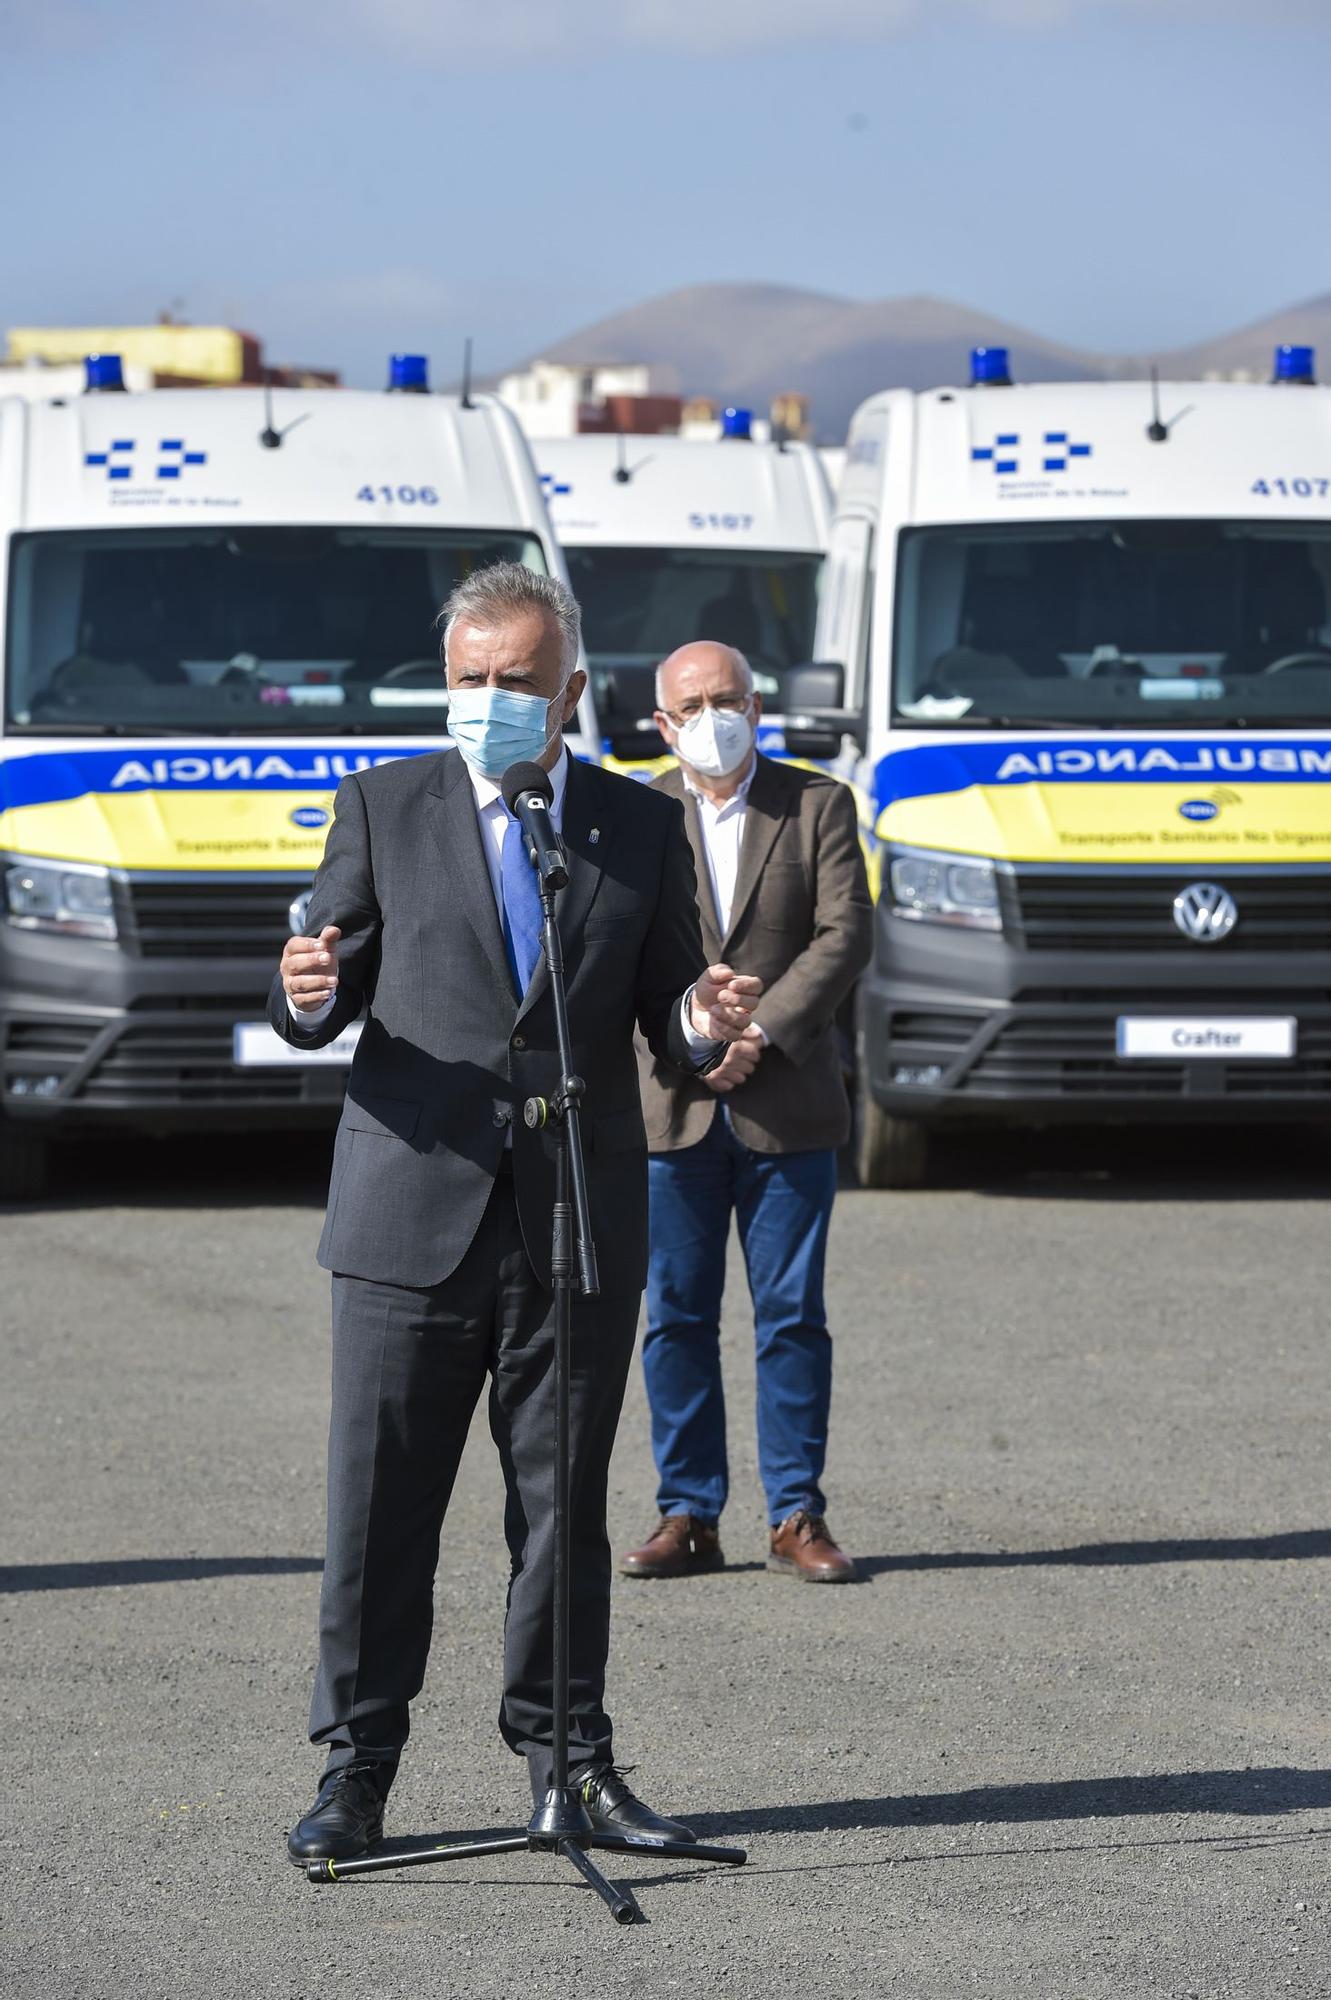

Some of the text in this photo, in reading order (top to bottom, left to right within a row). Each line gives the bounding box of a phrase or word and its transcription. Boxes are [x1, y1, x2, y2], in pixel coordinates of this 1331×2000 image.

[355, 484, 441, 506] 4106
[1249, 477, 1331, 499] 4107
[688, 512, 754, 530] 5107
[175, 838, 271, 854] Transporte
[1058, 830, 1154, 847] Transporte
[1159, 830, 1240, 844] Sanitario
[1243, 830, 1269, 843] No
[1171, 1027, 1243, 1048] Crafter
